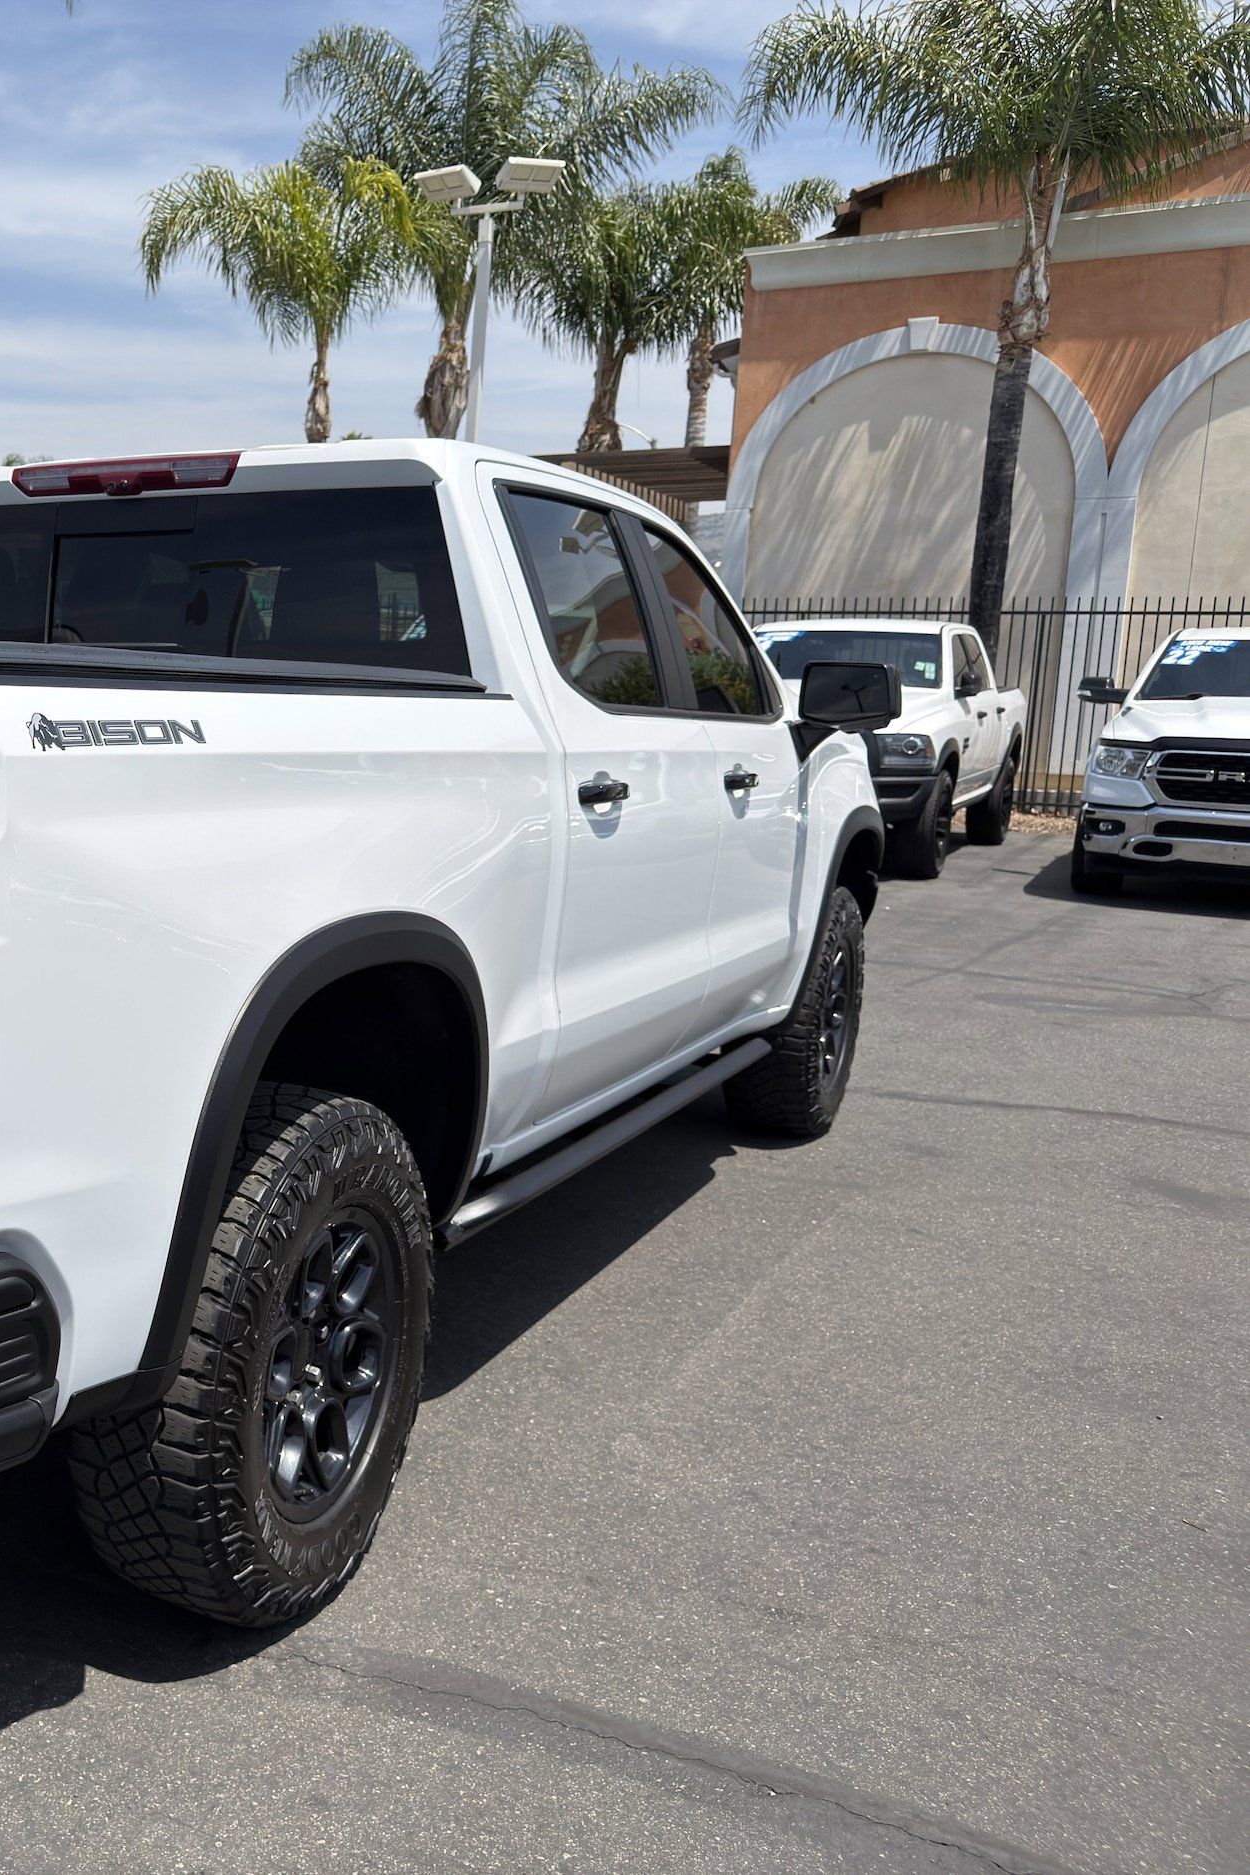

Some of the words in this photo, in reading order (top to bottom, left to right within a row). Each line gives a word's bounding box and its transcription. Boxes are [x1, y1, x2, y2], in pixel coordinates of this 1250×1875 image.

[1161, 649, 1200, 665] 22
[53, 719, 207, 747] BISON
[332, 1163, 422, 1249] WRANGLER
